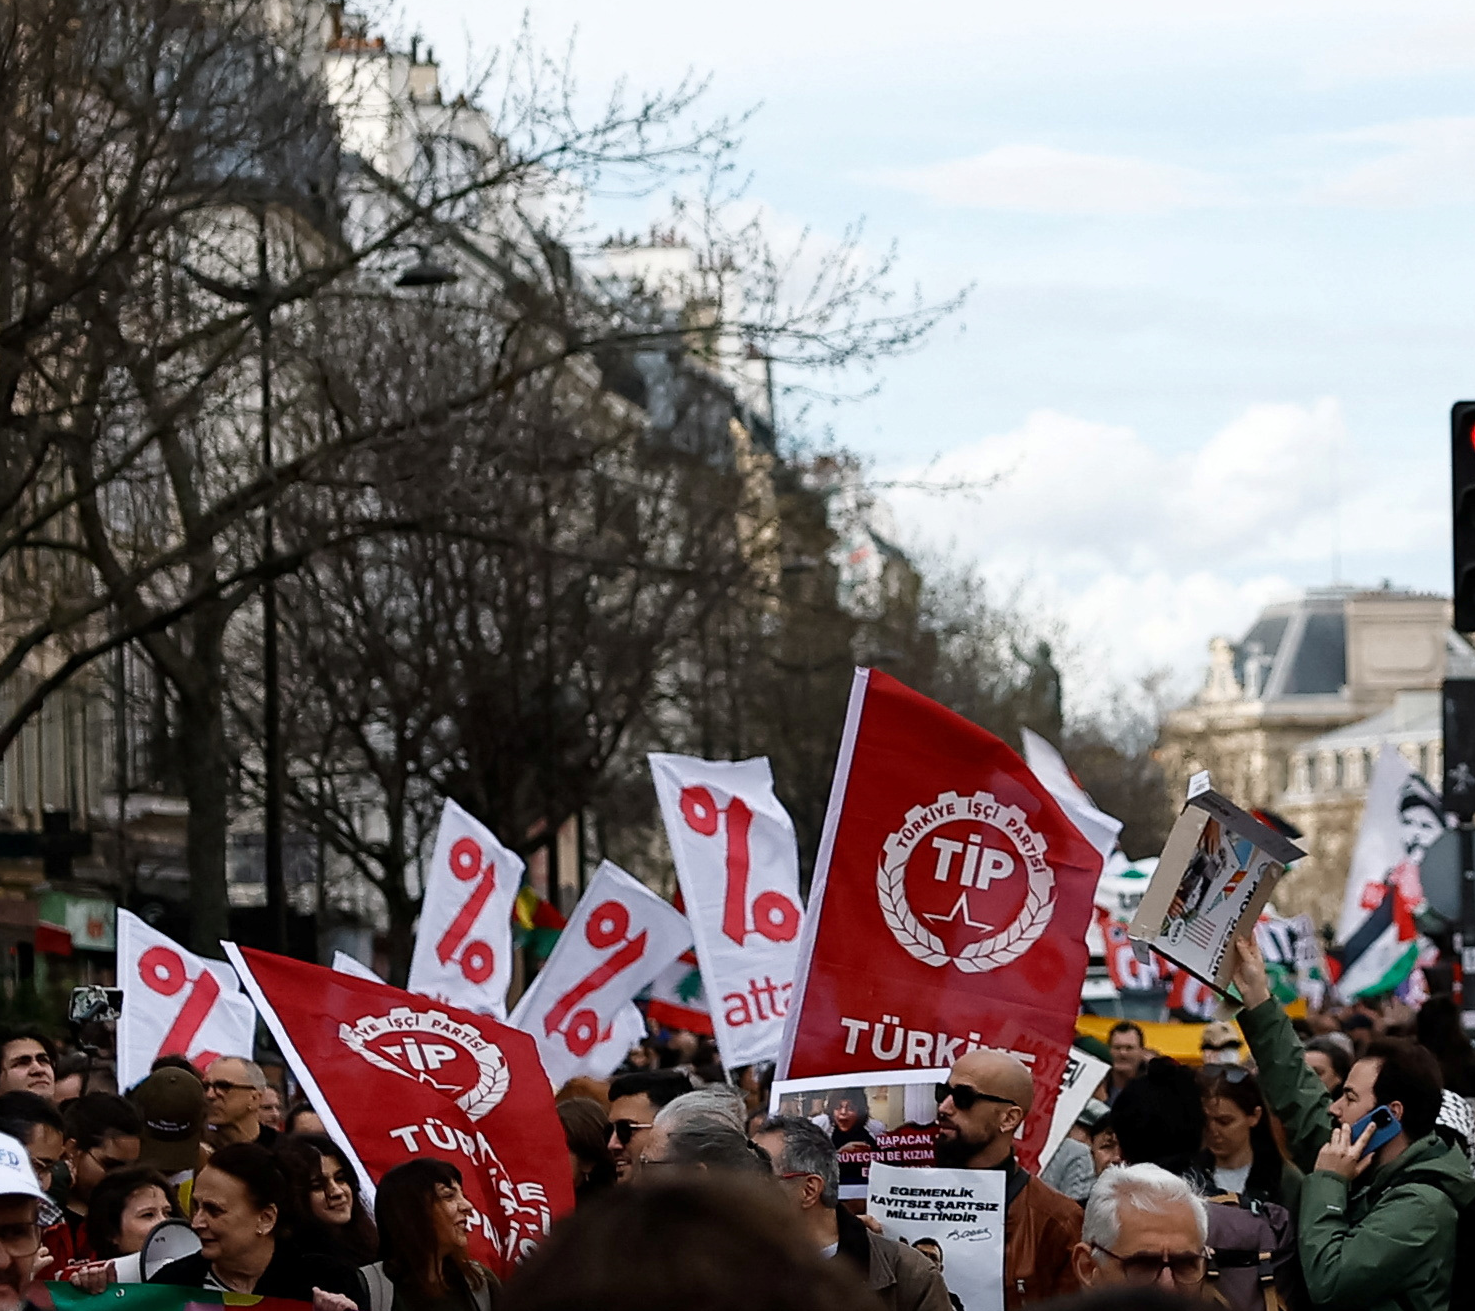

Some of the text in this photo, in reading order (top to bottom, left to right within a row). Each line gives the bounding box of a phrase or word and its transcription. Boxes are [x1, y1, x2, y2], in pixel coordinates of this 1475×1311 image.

[967, 799, 1001, 820] İŞÇİ
[1005, 817, 1047, 874] PARTİSİ
[932, 833, 1015, 891] TİP
[387, 1015, 420, 1030] İŞÇİ
[431, 1018, 489, 1053] PARTİSİ
[886, 1151, 901, 1161] BE
[903, 1150, 934, 1160] KIZIM
[889, 1186, 974, 1198] EGEMENLİK
[871, 1195, 999, 1214] KAYITSIZ ŞARTSIZ
[886, 1209, 978, 1223] MİLLETİNDİR
